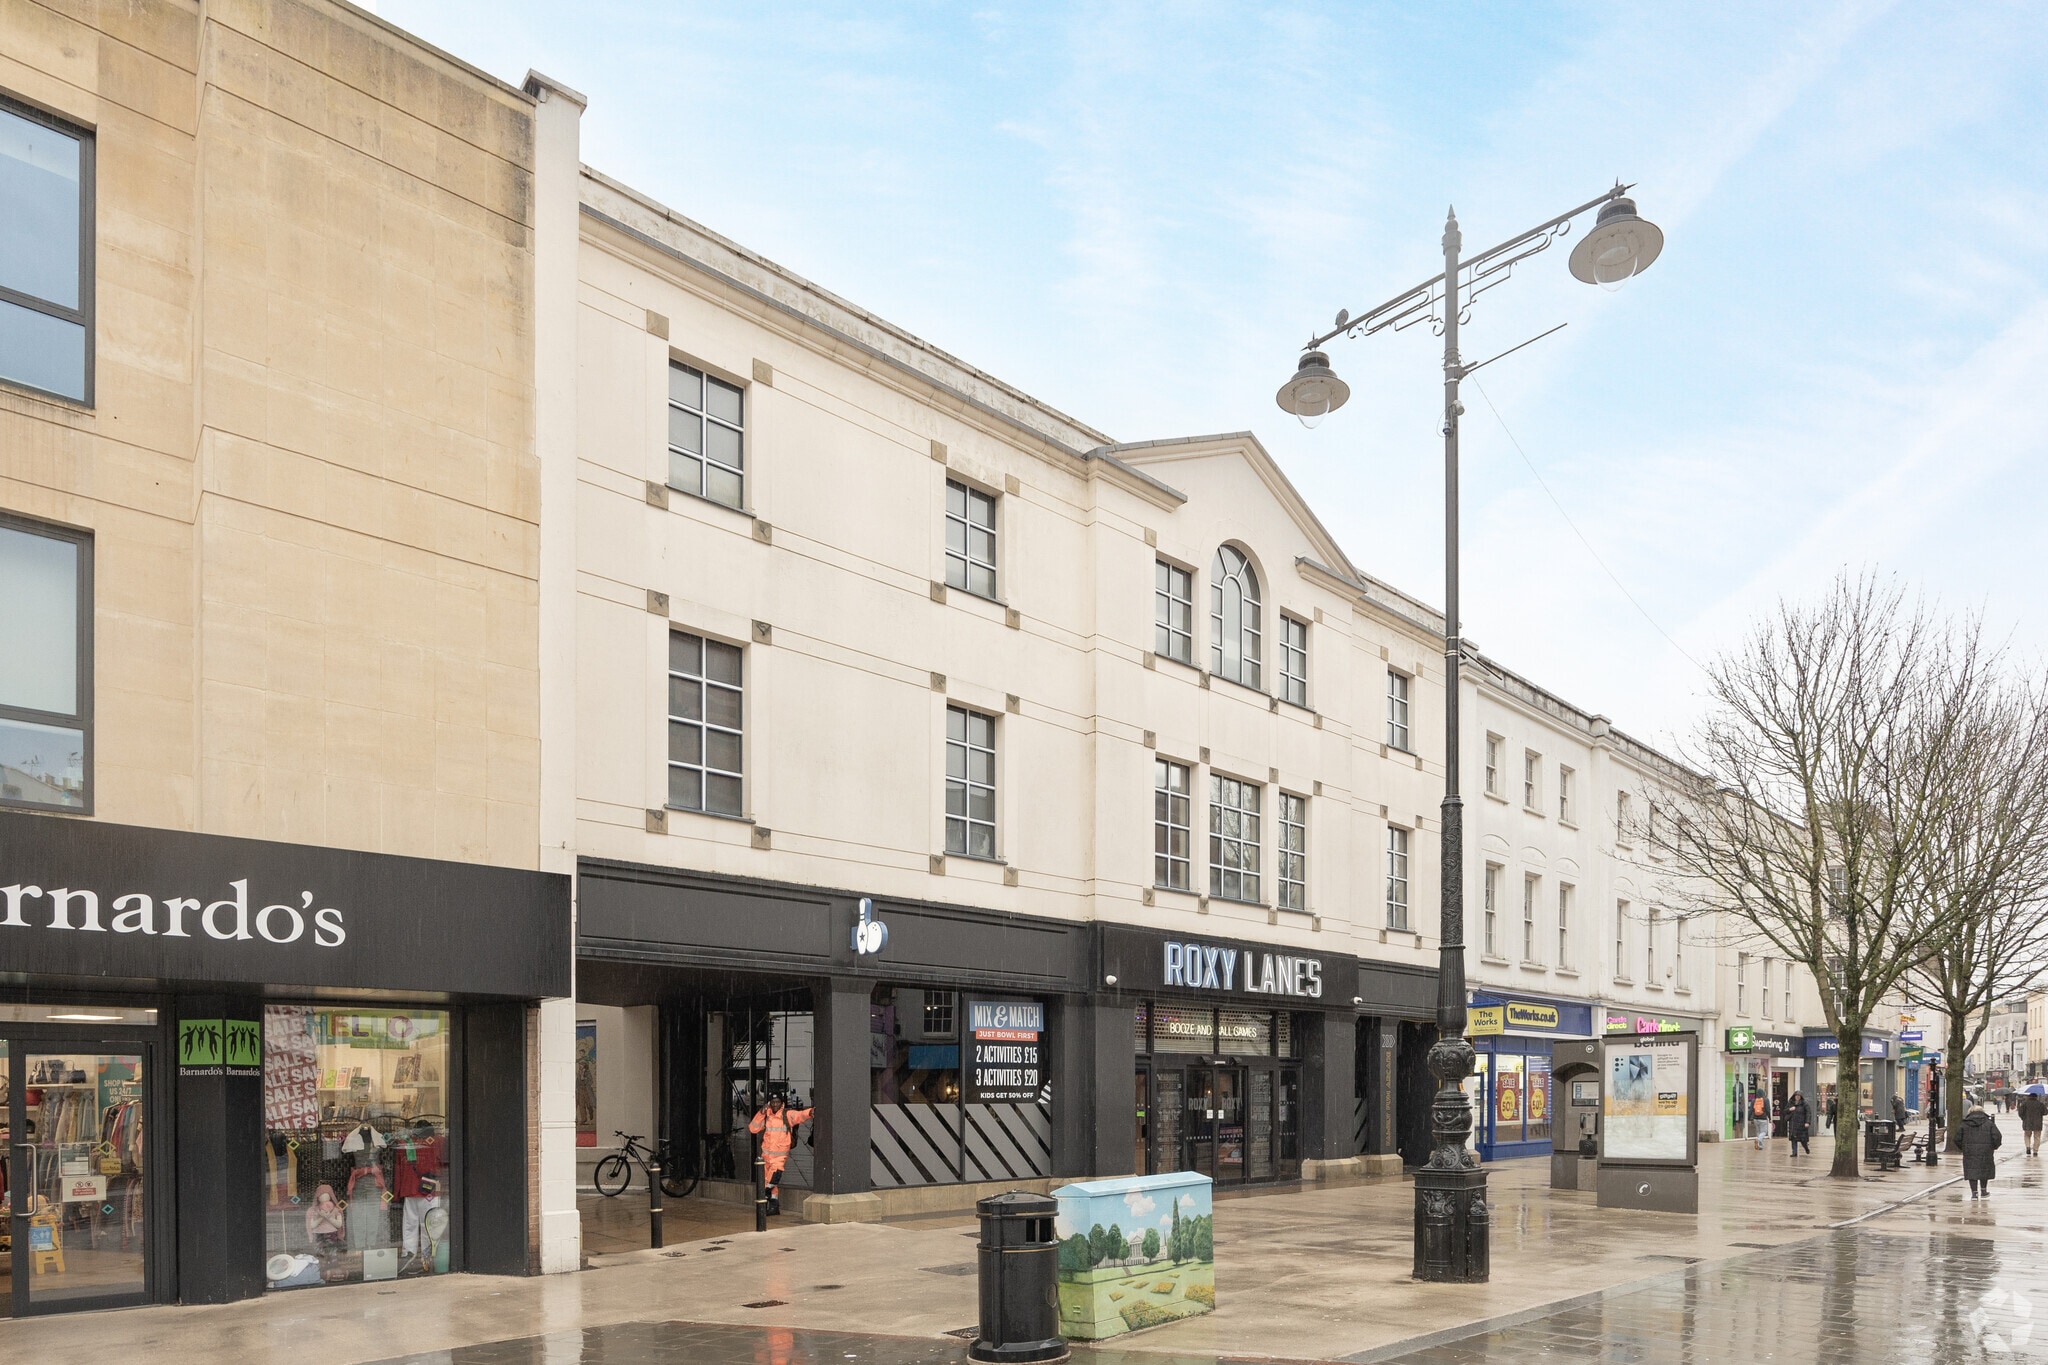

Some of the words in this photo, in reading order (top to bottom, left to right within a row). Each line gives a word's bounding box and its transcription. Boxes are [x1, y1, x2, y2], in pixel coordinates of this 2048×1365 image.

[0, 878, 346, 947] rnardo's
[1164, 941, 1237, 990] ROXY
[1244, 950, 1322, 998] LANES
[974, 1005, 992, 1027] MIX
[993, 1005, 1008, 1028] &
[1009, 1006, 1039, 1027] MATCH
[1474, 1018, 1498, 1026] Works
[1170, 1022, 1195, 1035] BOOZE
[1196, 1025, 1212, 1036] AND
[1219, 1027, 1232, 1037] ALL
[1233, 1026, 1257, 1038] GAMES
[1607, 1022, 1627, 1030] direct
[979, 1030, 995, 1038] JUST
[976, 1045, 982, 1063] 2
[983, 1046, 1022, 1063] ACTIVITIES
[1024, 1047, 1038, 1064] £15
[180, 1067, 223, 1076] Barnardo's
[226, 1067, 260, 1076] Barnardo's
[976, 1068, 982, 1086] 3
[983, 1069, 1022, 1086] ACTIVITIES
[1024, 1069, 1038, 1086] £20
[1503, 1079, 1515, 1088] SALE
[1188, 1098, 1208, 1110] ROXY
